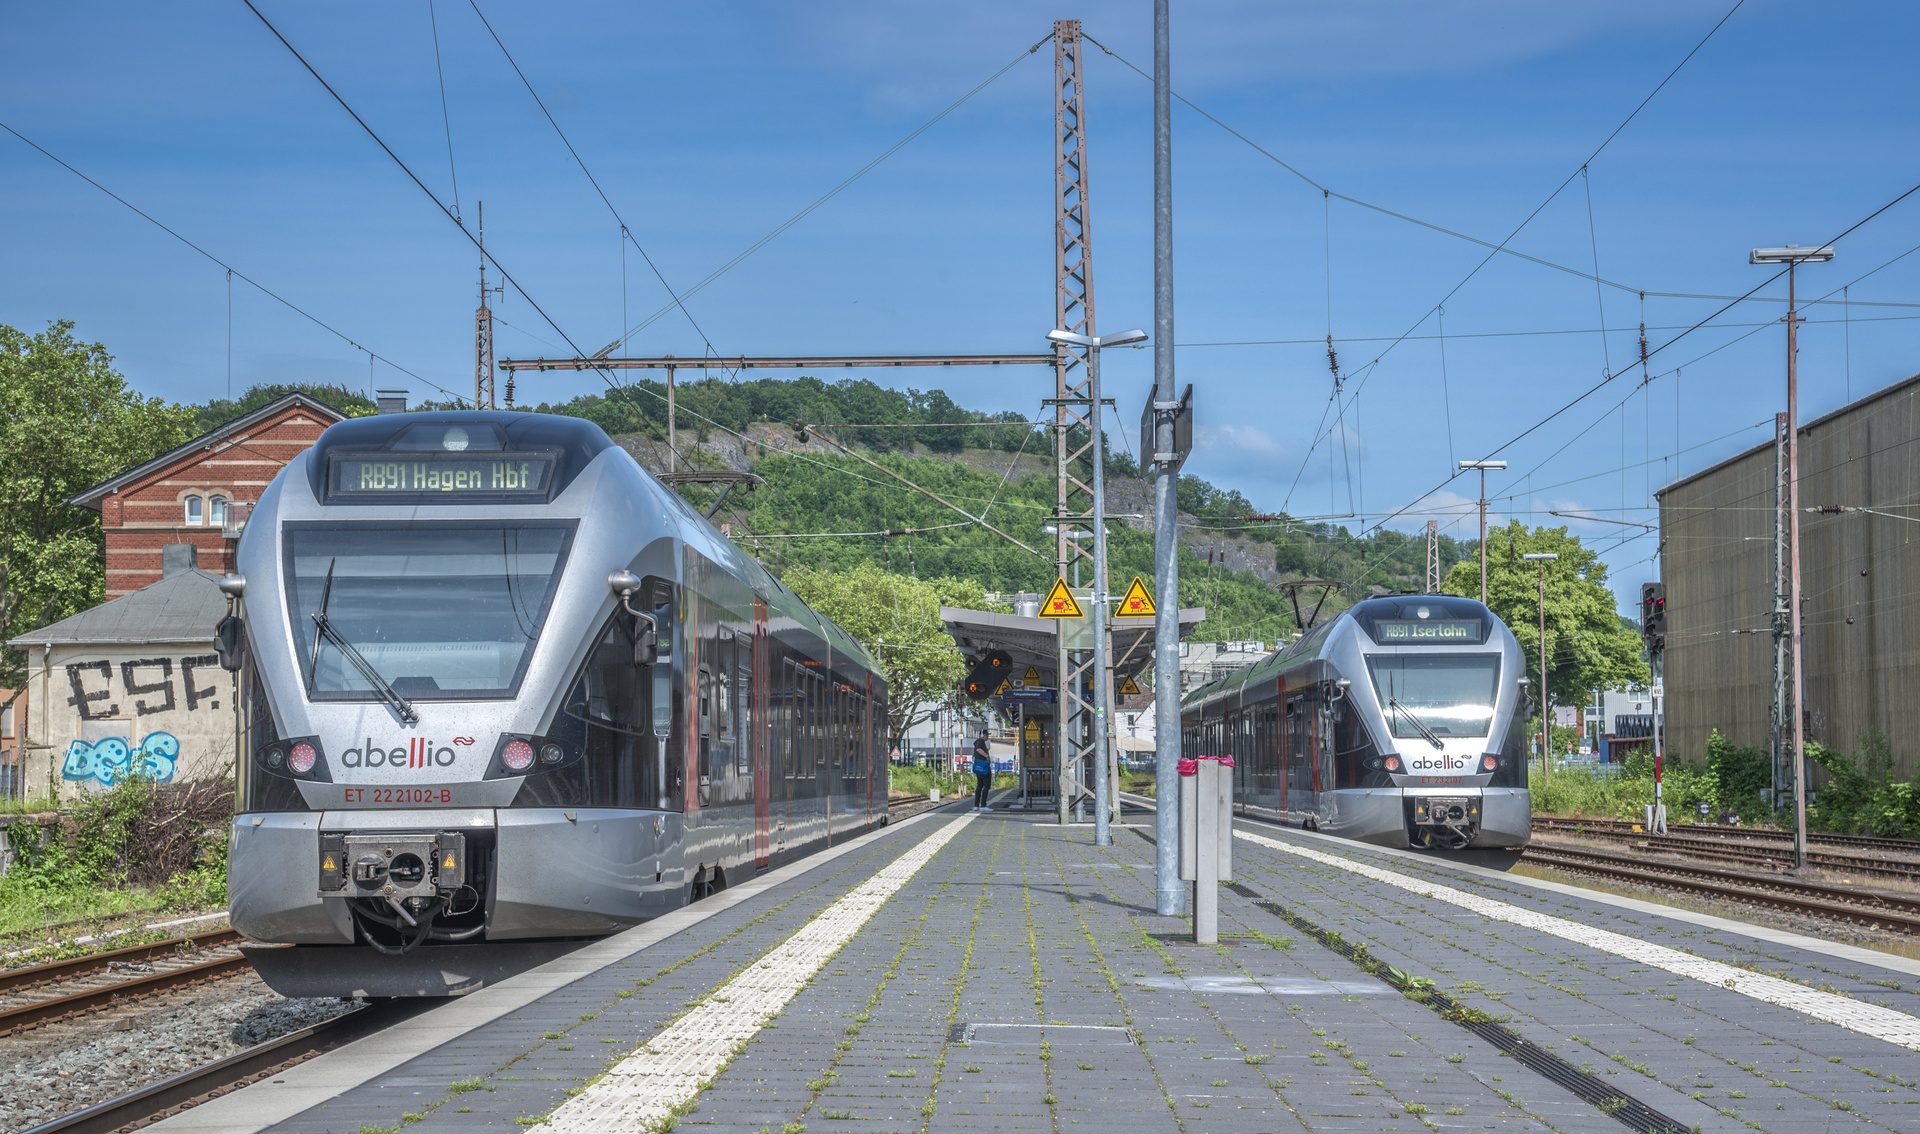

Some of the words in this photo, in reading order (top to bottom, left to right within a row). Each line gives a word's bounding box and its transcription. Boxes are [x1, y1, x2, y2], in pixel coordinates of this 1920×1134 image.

[361, 463, 406, 489] RB91
[413, 463, 482, 492] Hagen
[492, 463, 529, 489] Hbf
[1386, 624, 1409, 637] RB91
[1411, 624, 1467, 637] Iserlohn
[341, 737, 456, 769] abellio
[1412, 754, 1464, 770] abellio
[1421, 776, 1432, 784] ET
[345, 788, 365, 803] ET
[373, 788, 452, 803] 222102-B
